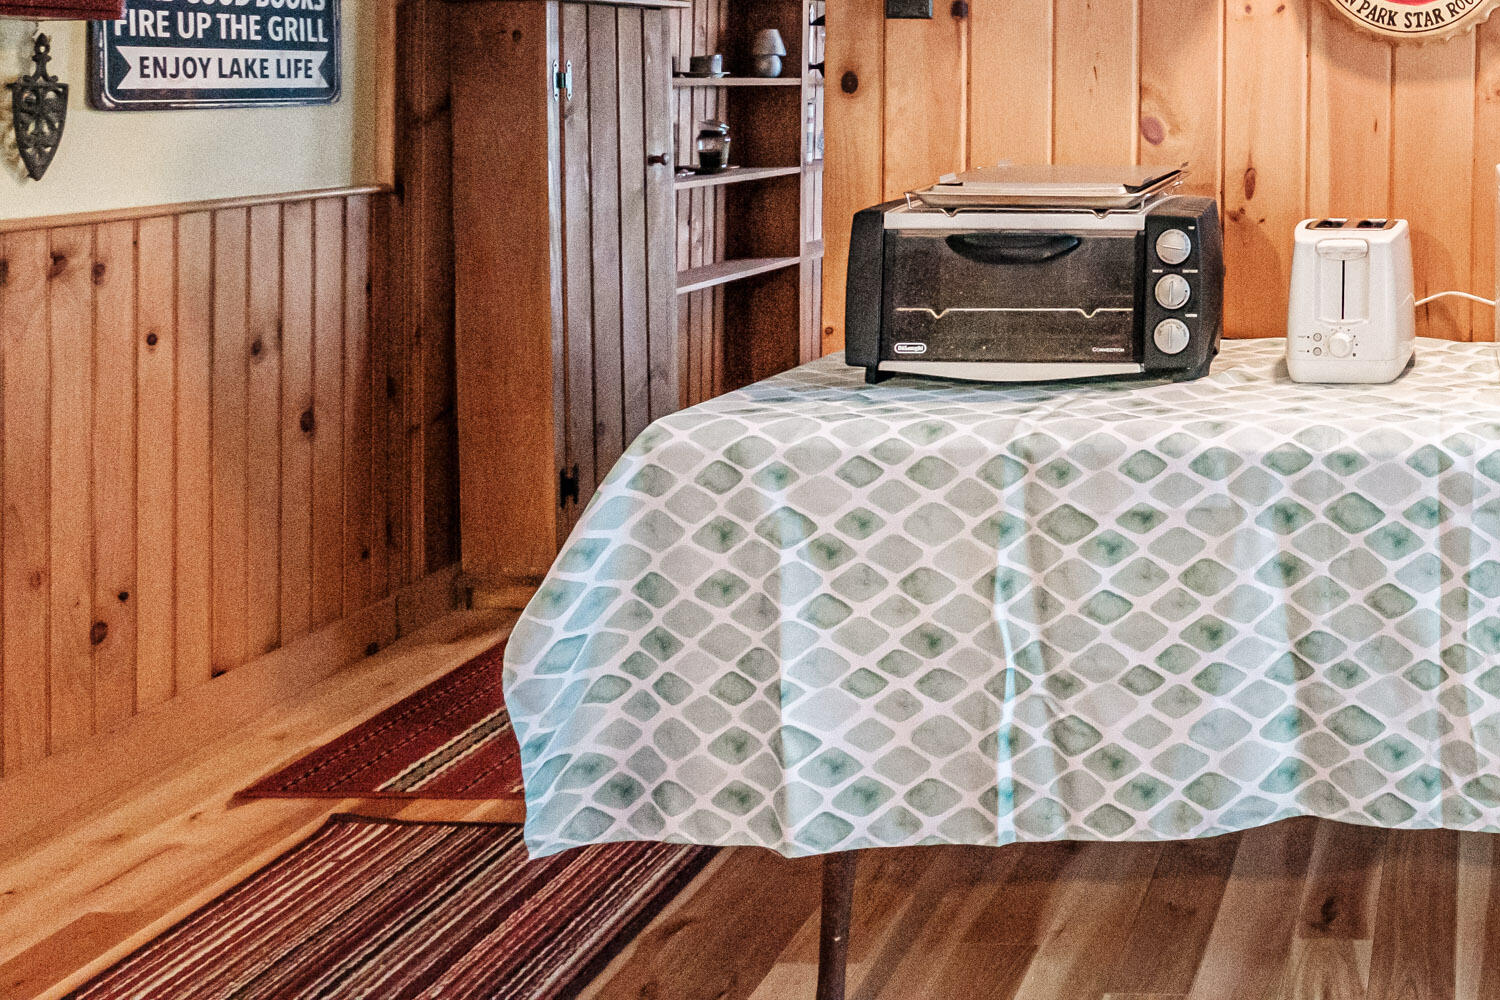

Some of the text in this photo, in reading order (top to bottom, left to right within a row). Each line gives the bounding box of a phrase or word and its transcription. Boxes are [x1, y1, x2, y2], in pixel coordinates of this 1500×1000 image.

[177, 11, 212, 39] UP
[216, 13, 262, 41] THE
[268, 16, 329, 43] GRILL
[1357, 0, 1398, 27] PARK
[1404, 8, 1446, 29] STAR
[138, 55, 313, 80] ENJOY LAKE LIFE
